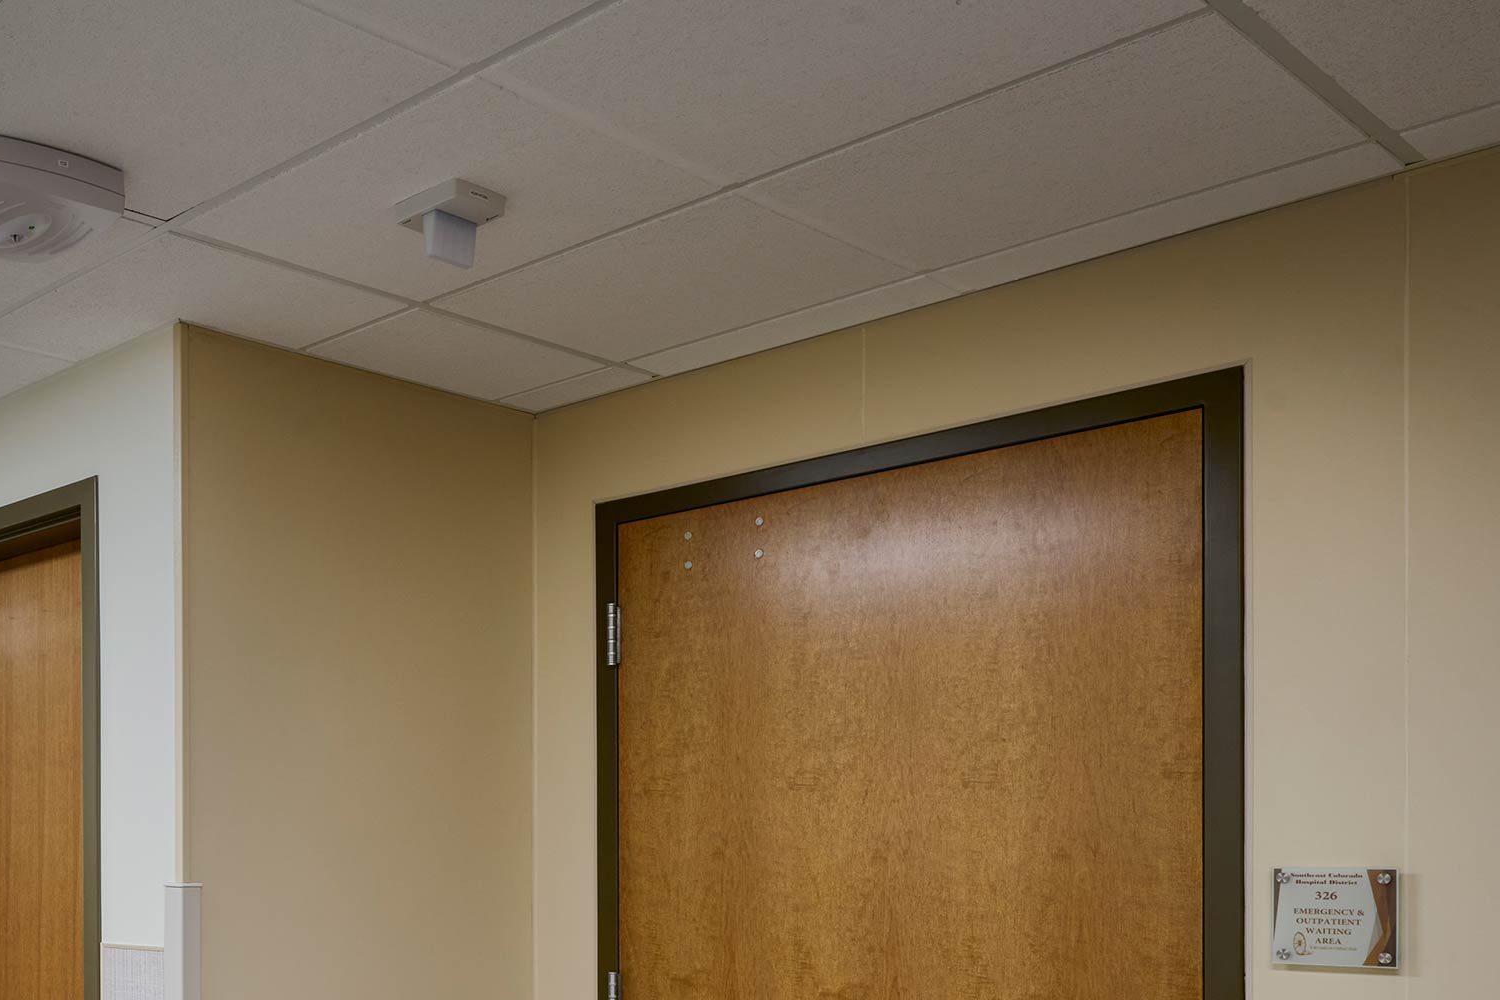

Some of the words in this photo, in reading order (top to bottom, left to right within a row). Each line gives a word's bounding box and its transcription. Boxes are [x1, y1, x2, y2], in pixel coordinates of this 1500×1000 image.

[1315, 891, 1338, 901] 326
[1293, 908, 1355, 916] EMERGENCY
[1357, 909, 1365, 917] &
[1296, 917, 1362, 926] OUTPATIENT
[1306, 927, 1352, 936] WAITING
[1315, 937, 1342, 945] AREA
